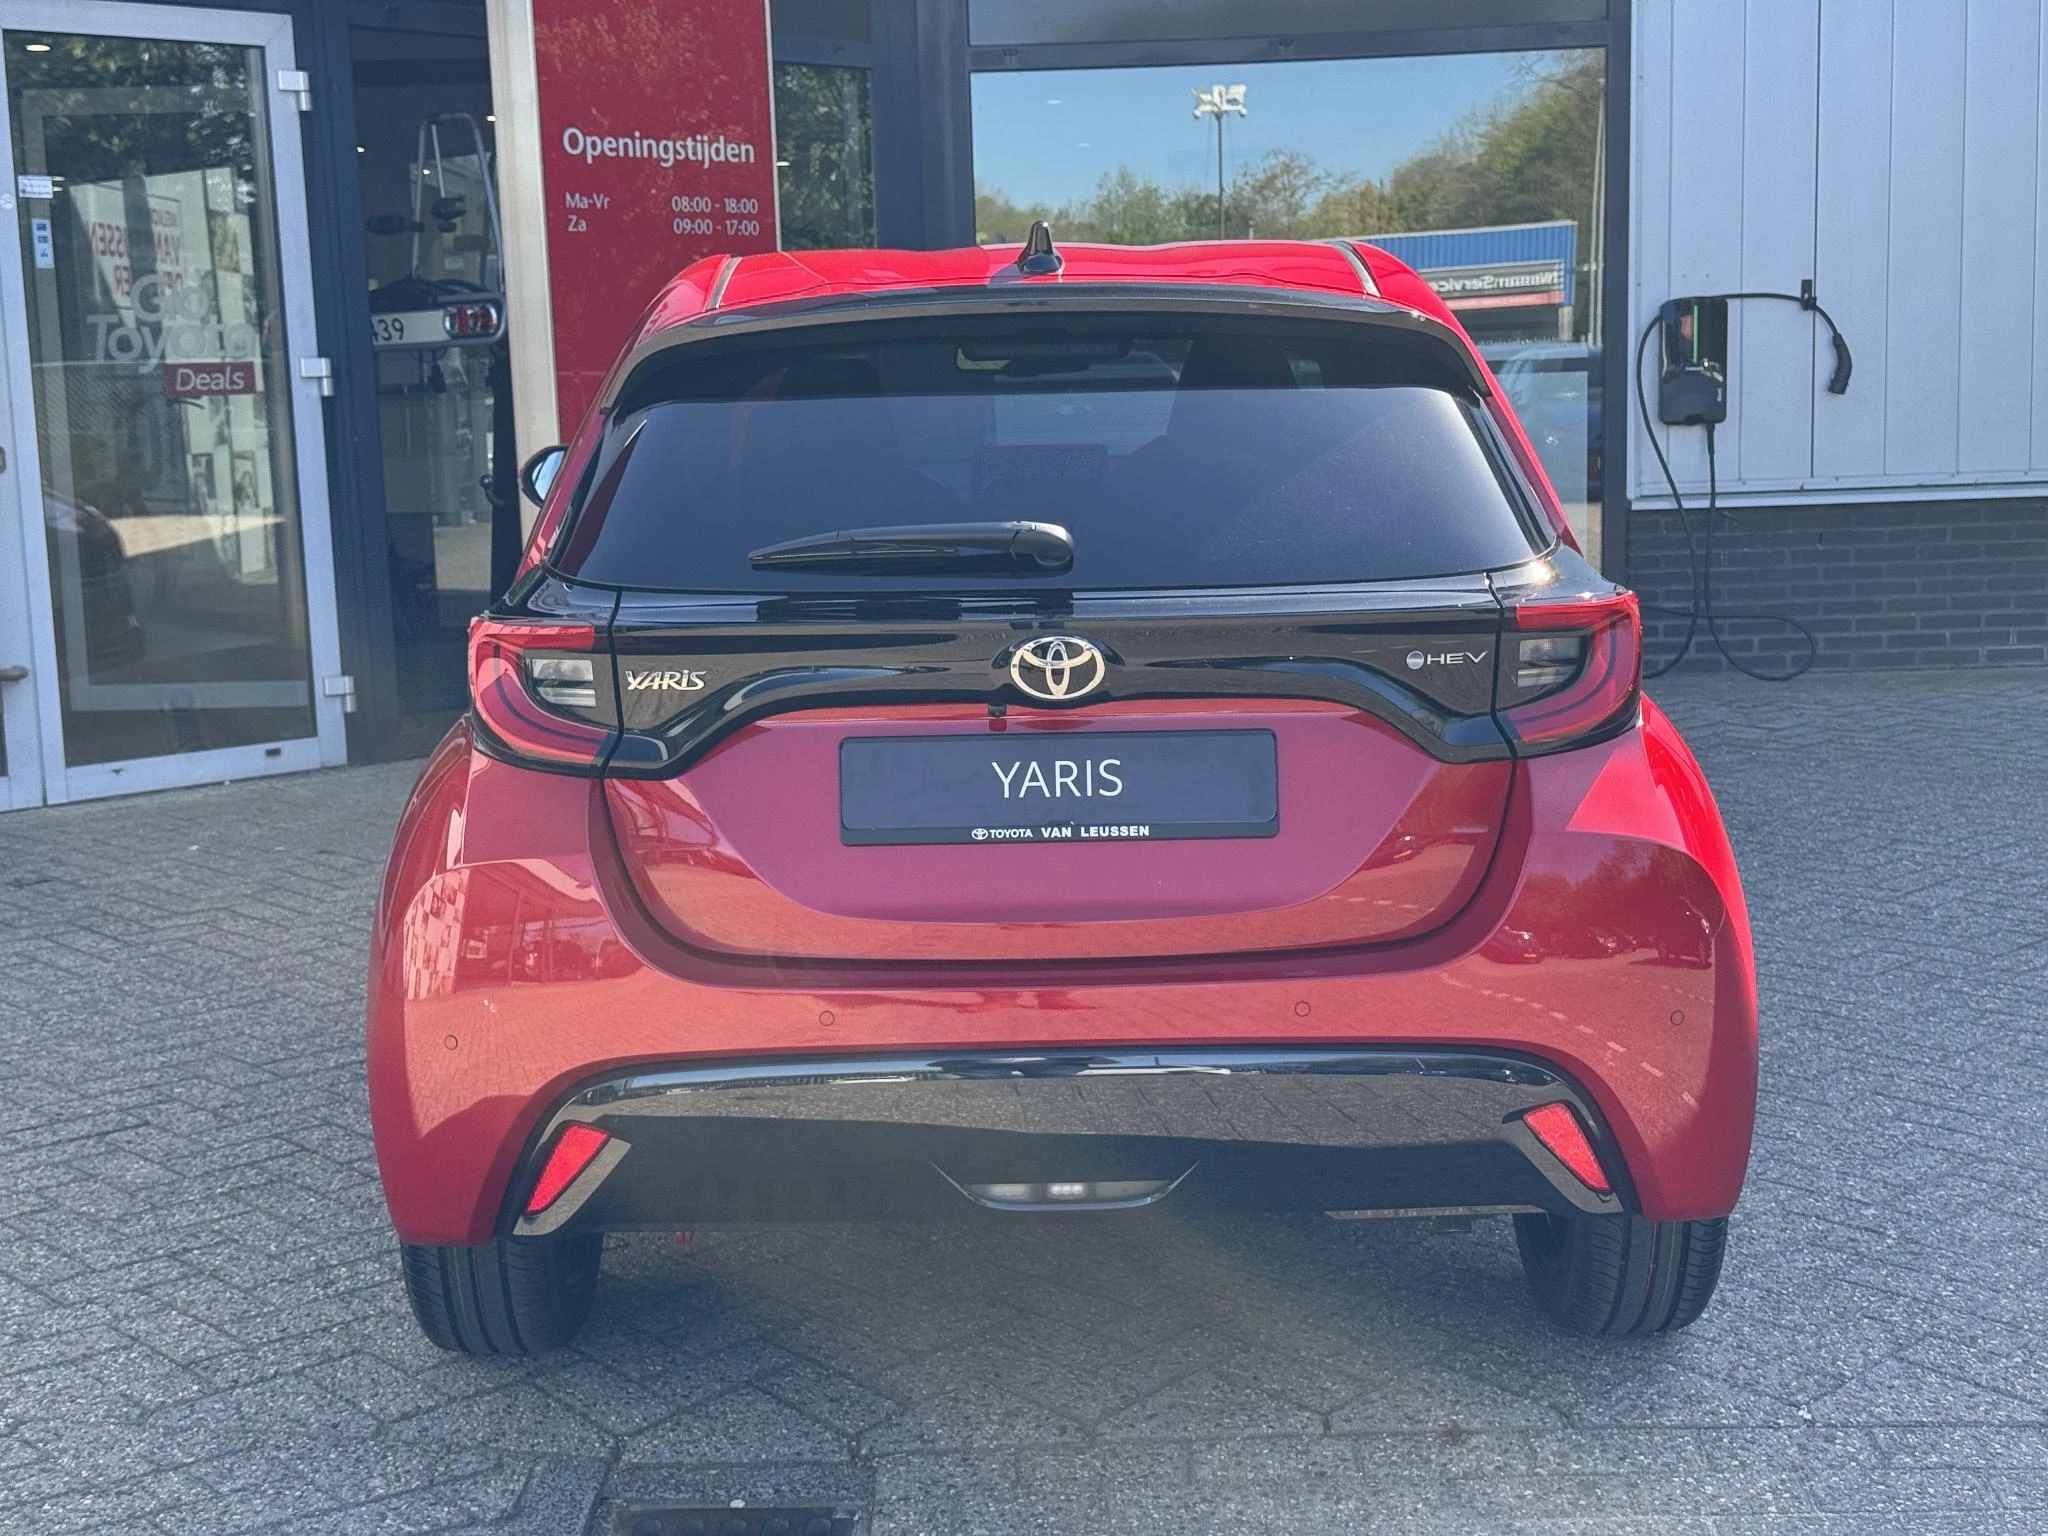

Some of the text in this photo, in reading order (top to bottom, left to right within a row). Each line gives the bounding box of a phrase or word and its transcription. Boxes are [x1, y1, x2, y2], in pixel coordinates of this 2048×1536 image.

[563, 127, 755, 169] Openingstijden
[565, 192, 610, 209] Ma-Vr
[671, 196, 711, 213] 08:00
[725, 198, 759, 214] 18:00
[568, 215, 587, 232] Za
[673, 218, 713, 235] 09:00
[726, 220, 760, 236] 17:00
[131, 273, 209, 322] Go
[86, 314, 259, 374] Toyota
[176, 366, 245, 391] Deals
[1426, 650, 1488, 665] HEV
[991, 758, 1124, 799] YARIS
[989, 825, 1150, 839] TOYOTA VAN LEUSSEN
